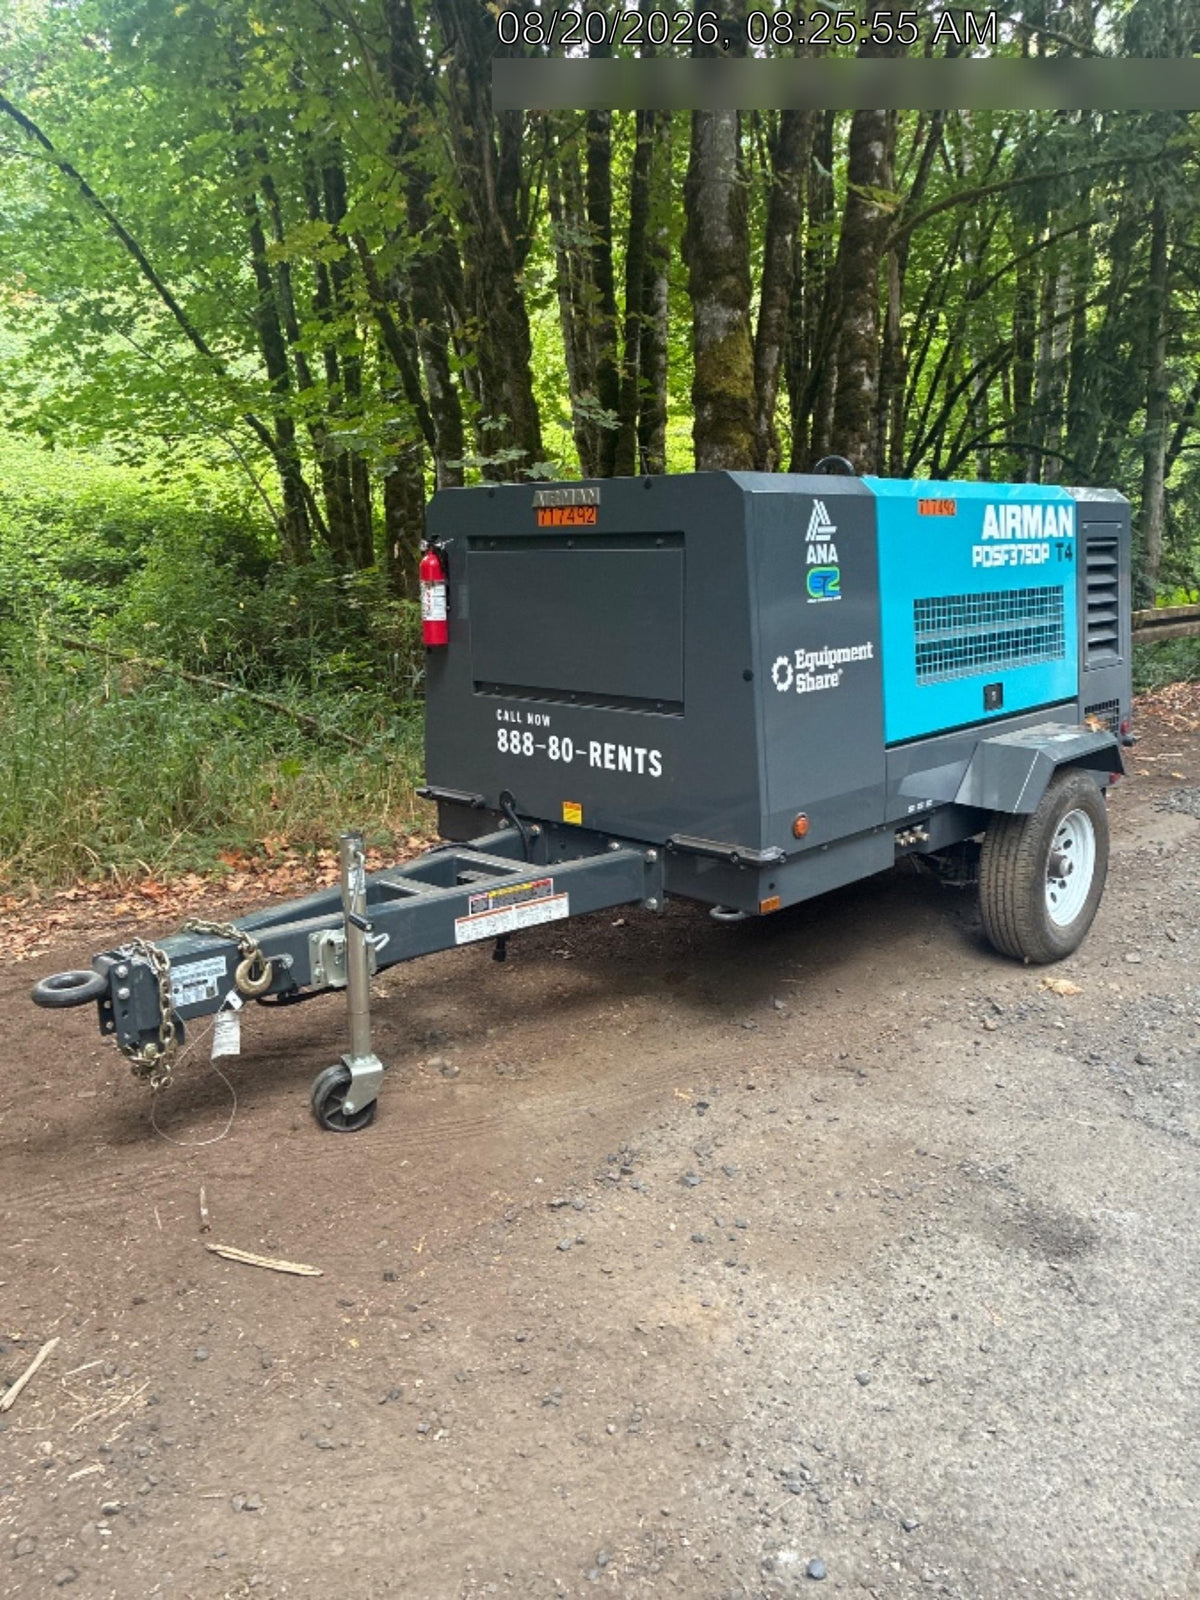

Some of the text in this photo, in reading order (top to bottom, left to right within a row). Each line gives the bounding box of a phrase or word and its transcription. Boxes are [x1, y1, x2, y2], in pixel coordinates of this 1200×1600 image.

[540, 506, 595, 525] 717492
[981, 504, 1074, 540] AIRMAN
[805, 543, 839, 564] ANA
[1055, 542, 1074, 562] T4
[794, 641, 874, 672] Equipment
[496, 709, 550, 727] CALL NOW
[497, 728, 662, 778] 888-80-RENTS
